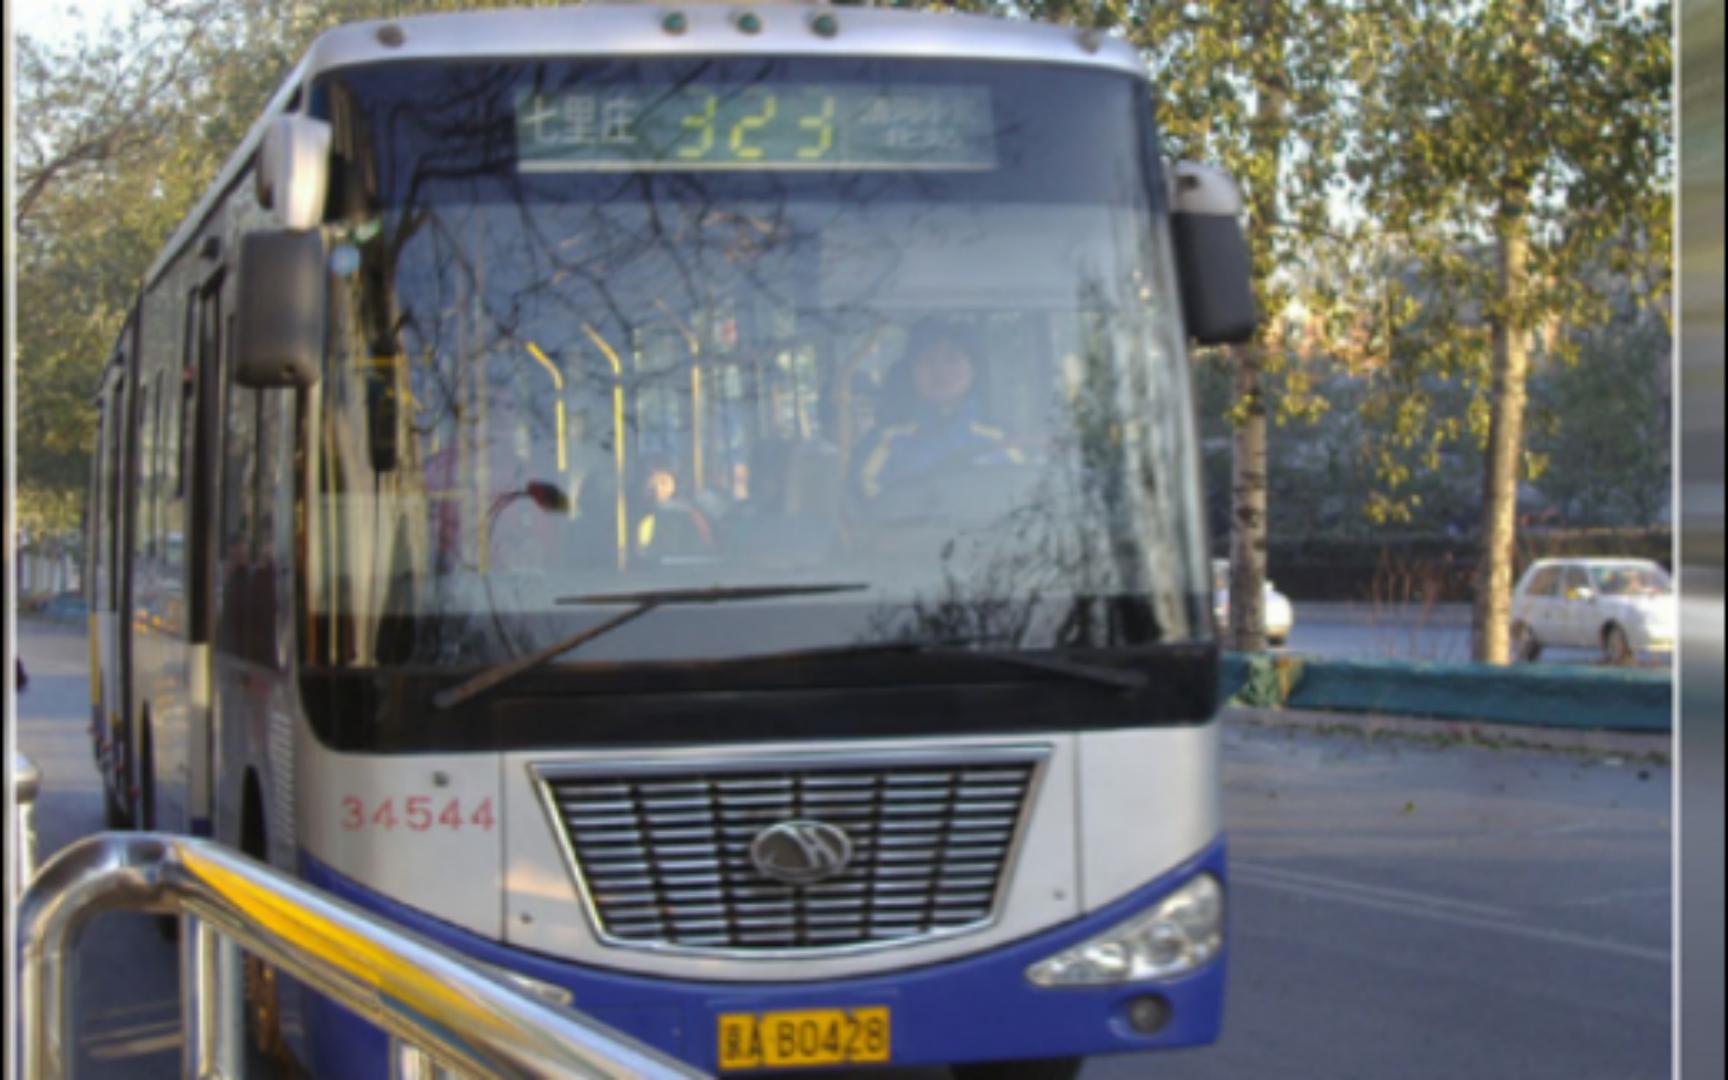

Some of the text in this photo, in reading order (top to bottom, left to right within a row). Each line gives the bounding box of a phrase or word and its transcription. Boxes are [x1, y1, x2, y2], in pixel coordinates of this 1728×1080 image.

[519, 94, 639, 145] 七里庄
[677, 87, 835, 158] 323
[340, 794, 498, 832] 34544
